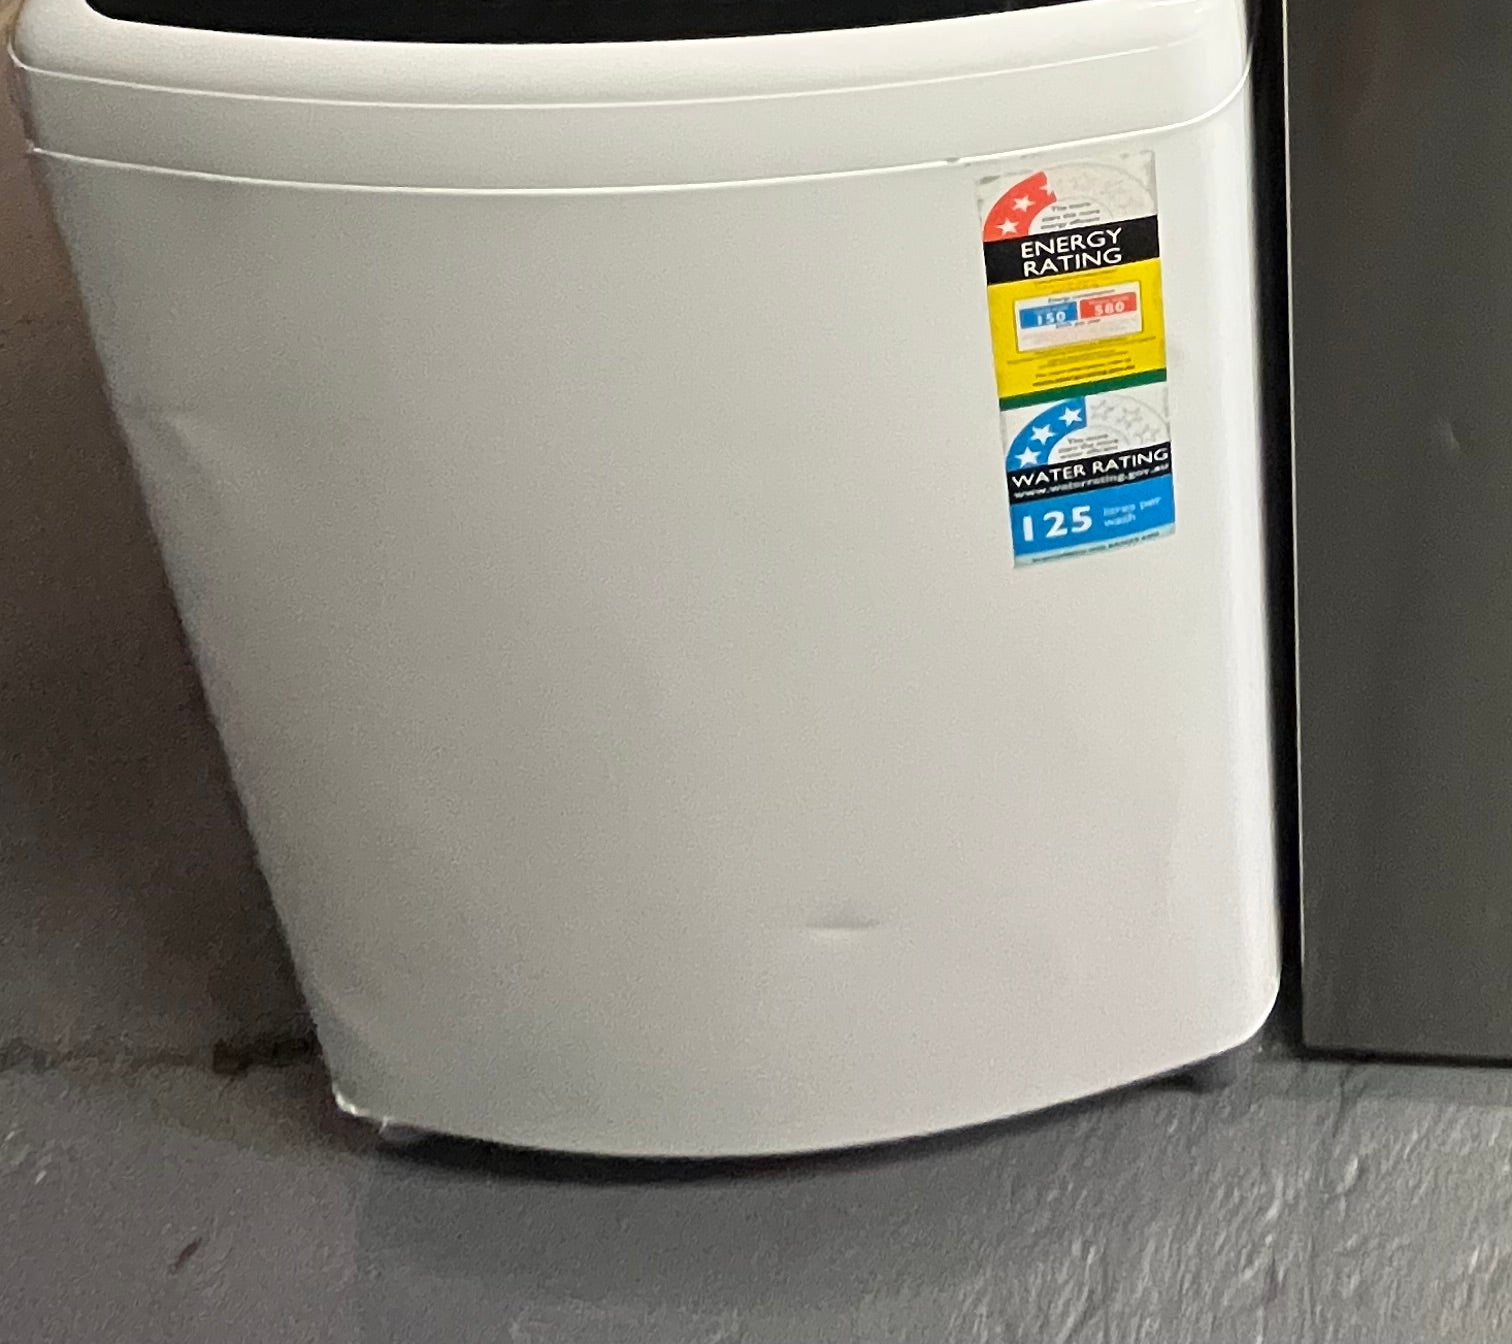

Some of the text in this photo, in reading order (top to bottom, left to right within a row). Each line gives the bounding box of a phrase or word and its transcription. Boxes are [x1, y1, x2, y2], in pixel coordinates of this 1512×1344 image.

[1021, 226, 1123, 259] ENERGY
[1023, 247, 1123, 278] RATING
[1037, 311, 1067, 326] 150
[1012, 448, 1169, 488] WATER RATING
[1013, 463, 1169, 499] www.waterrating.gov.au
[1022, 505, 1093, 542] 125
[1139, 496, 1162, 510] per
[1104, 513, 1136, 527] wash
